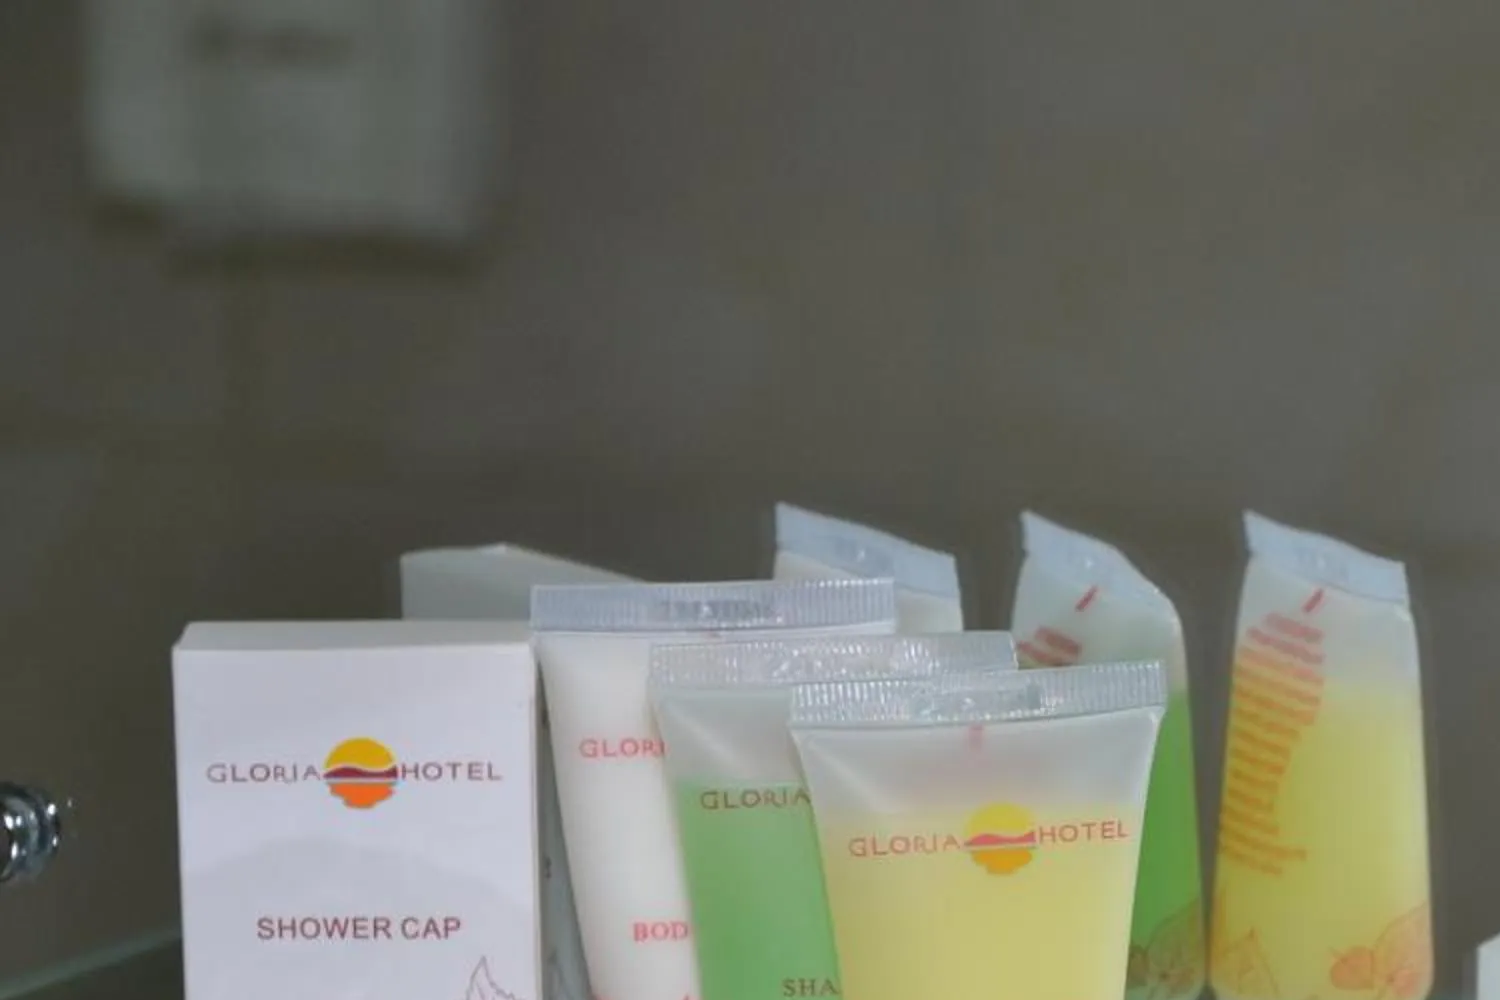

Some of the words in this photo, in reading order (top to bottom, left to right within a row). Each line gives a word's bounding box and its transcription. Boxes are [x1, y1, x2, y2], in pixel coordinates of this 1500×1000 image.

[577, 738, 667, 758] GLORI
[205, 762, 322, 785] GLORIA
[401, 760, 504, 783] HOTEL
[700, 788, 811, 811] GLORIA
[847, 834, 963, 858] GLORIA
[1037, 819, 1130, 846] HOTEL
[255, 915, 393, 942] SHOWER
[399, 915, 464, 941] CAP
[632, 921, 690, 942] BOD
[782, 976, 841, 998] SHA
